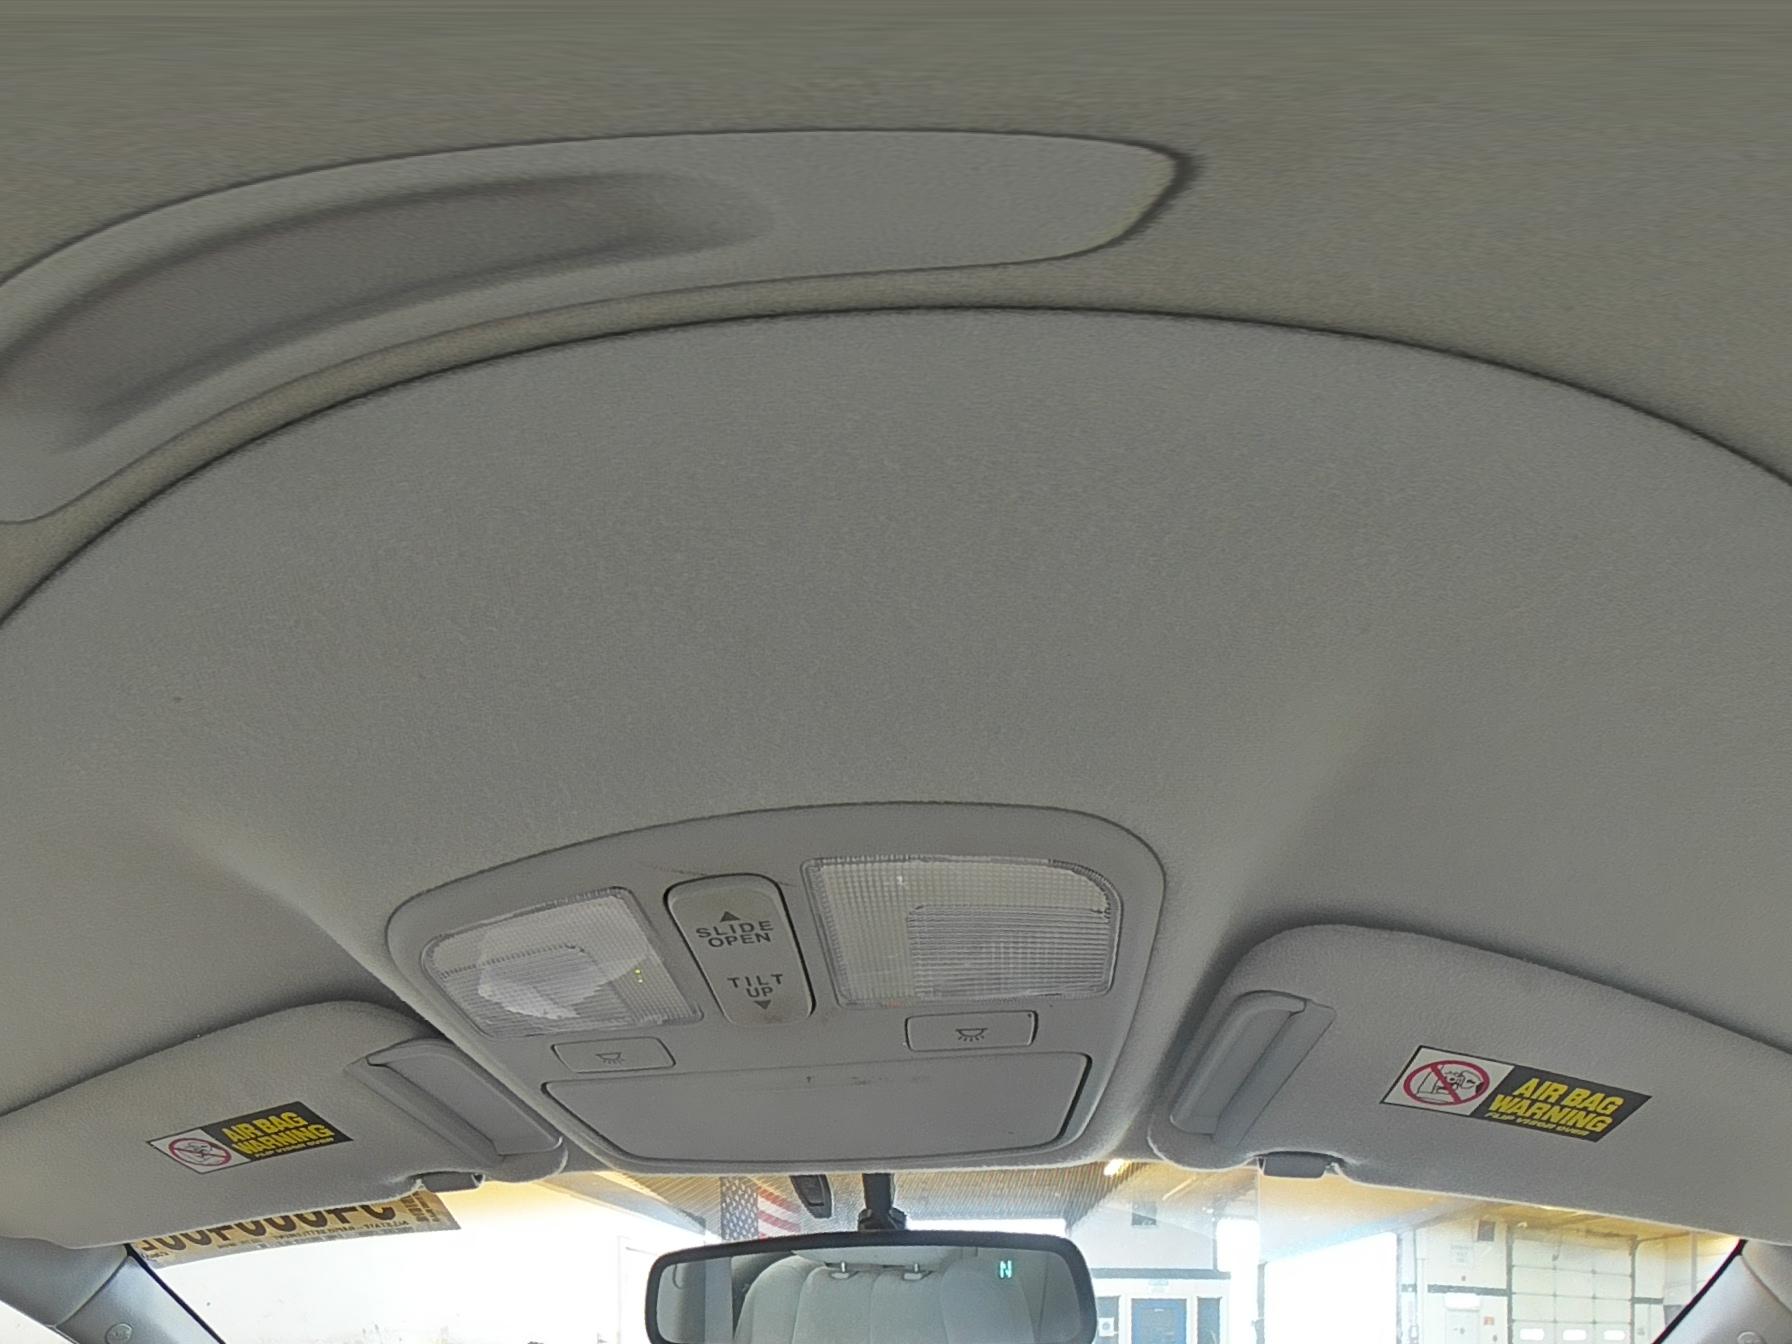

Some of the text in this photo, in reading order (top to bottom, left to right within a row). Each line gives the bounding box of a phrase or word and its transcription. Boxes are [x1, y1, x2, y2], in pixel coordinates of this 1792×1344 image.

[696, 920, 774, 938] SLIDE
[708, 932, 771, 947] OPEN
[727, 973, 783, 989] TILT
[746, 986, 773, 998] UP
[1513, 1078, 1624, 1115] AIR BAG
[1488, 1094, 1613, 1133] WARNING
[222, 1112, 308, 1142] AIR BAG
[232, 1124, 334, 1155] WARNING
[999, 1260, 1012, 1279] N
